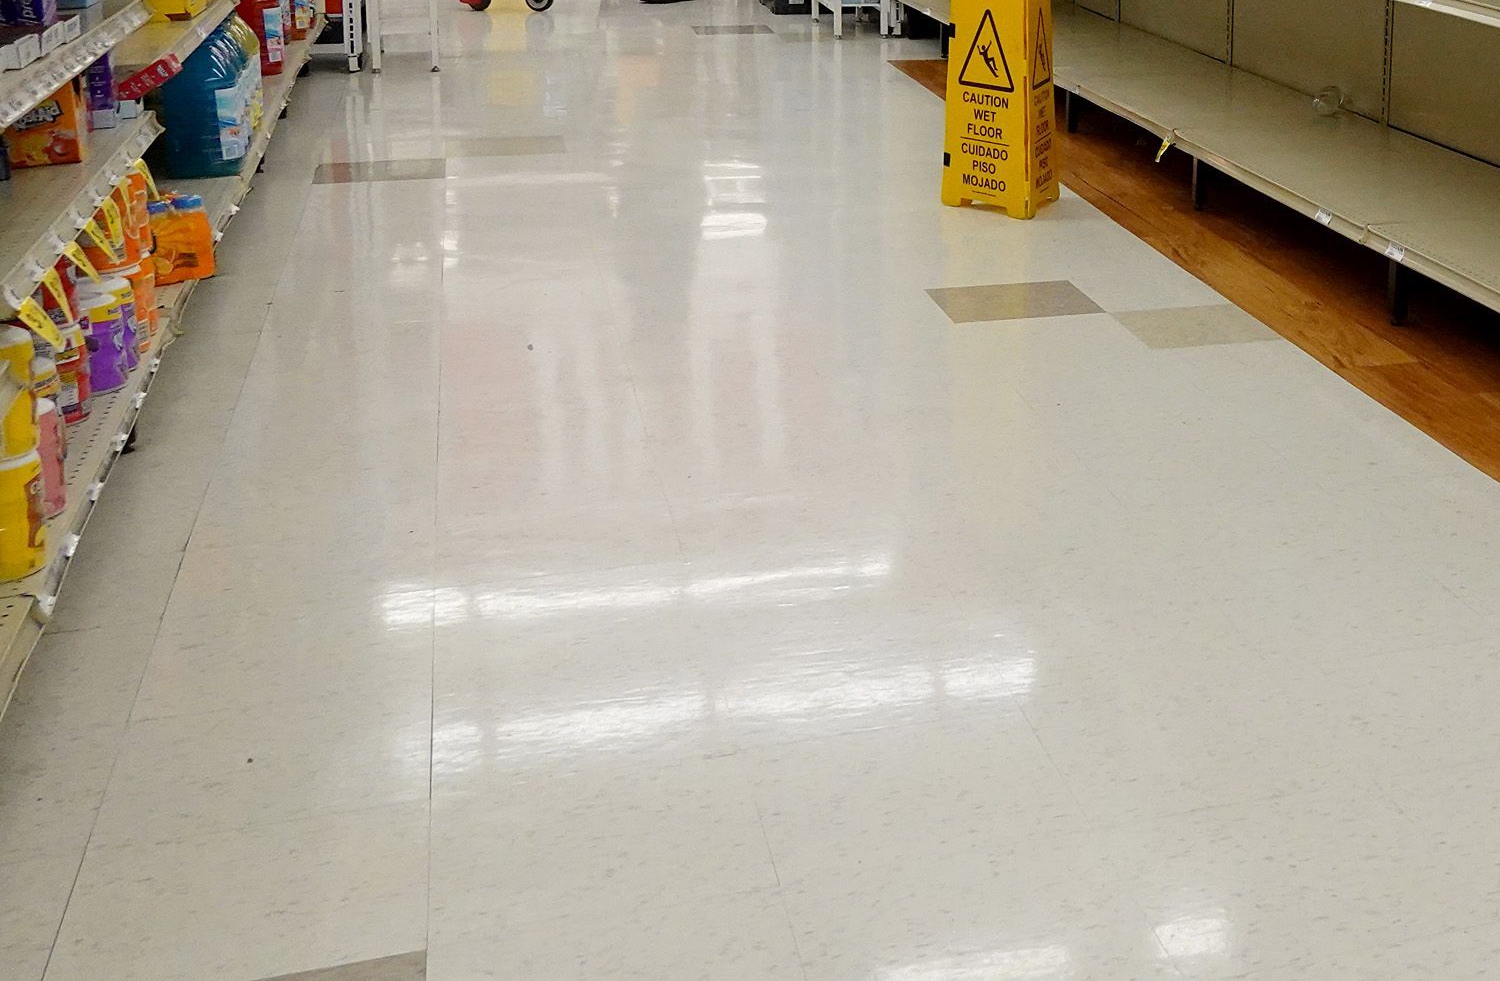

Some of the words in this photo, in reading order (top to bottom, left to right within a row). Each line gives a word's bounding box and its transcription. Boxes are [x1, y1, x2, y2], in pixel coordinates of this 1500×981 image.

[962, 91, 1010, 109] CAUTION
[973, 108, 997, 122] WET
[967, 123, 1003, 139] FLOOR
[961, 142, 1009, 161] CUIDADO
[972, 160, 997, 174] PISO
[962, 173, 1007, 192] MOJADO
